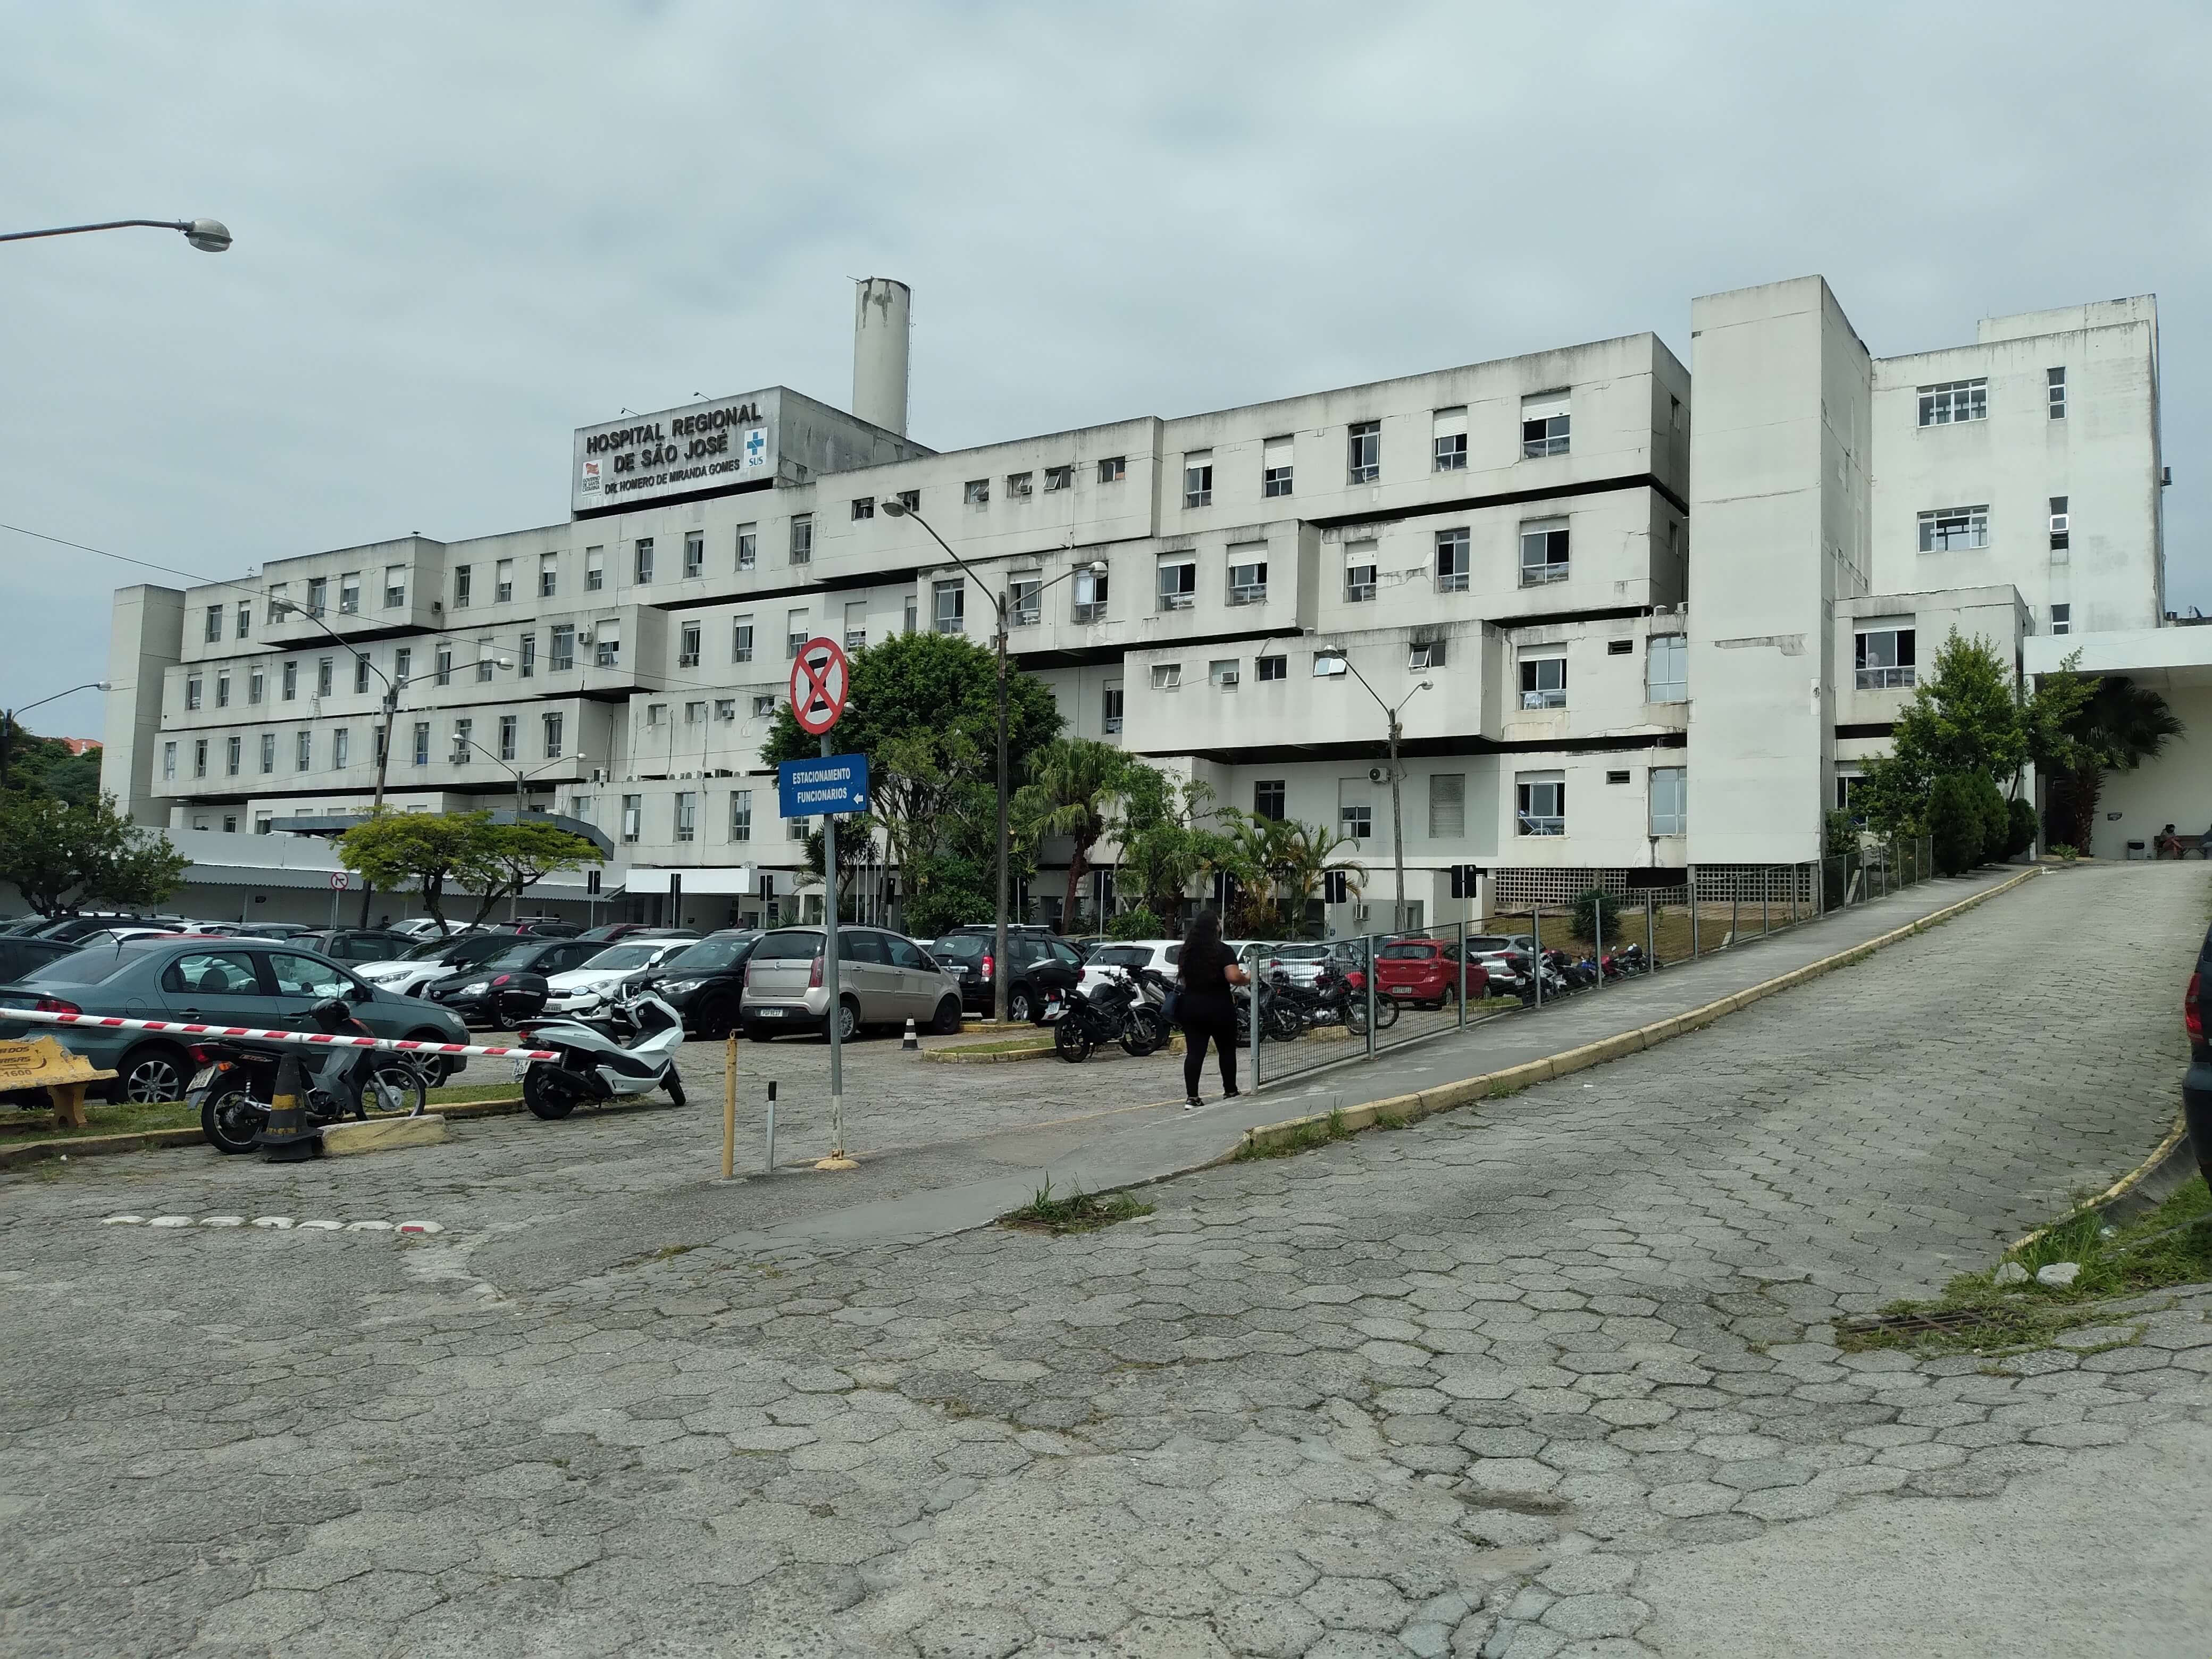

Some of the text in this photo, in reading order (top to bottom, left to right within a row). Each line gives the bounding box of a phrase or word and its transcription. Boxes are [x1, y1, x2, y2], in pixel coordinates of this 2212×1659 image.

[586, 403, 762, 454] HOSPITAL REGIONAL
[614, 429, 728, 473] DE SÃO JOSÉ
[749, 456, 763, 466] SUS
[619, 475, 655, 492] HOMERO
[656, 473, 668, 485] DE
[669, 465, 707, 483] MIRANDA
[709, 458, 741, 475] GOMES
[792, 767, 851, 785] ESTACIONAMENTO
[797, 787, 847, 804] FUNCIONARIOS
